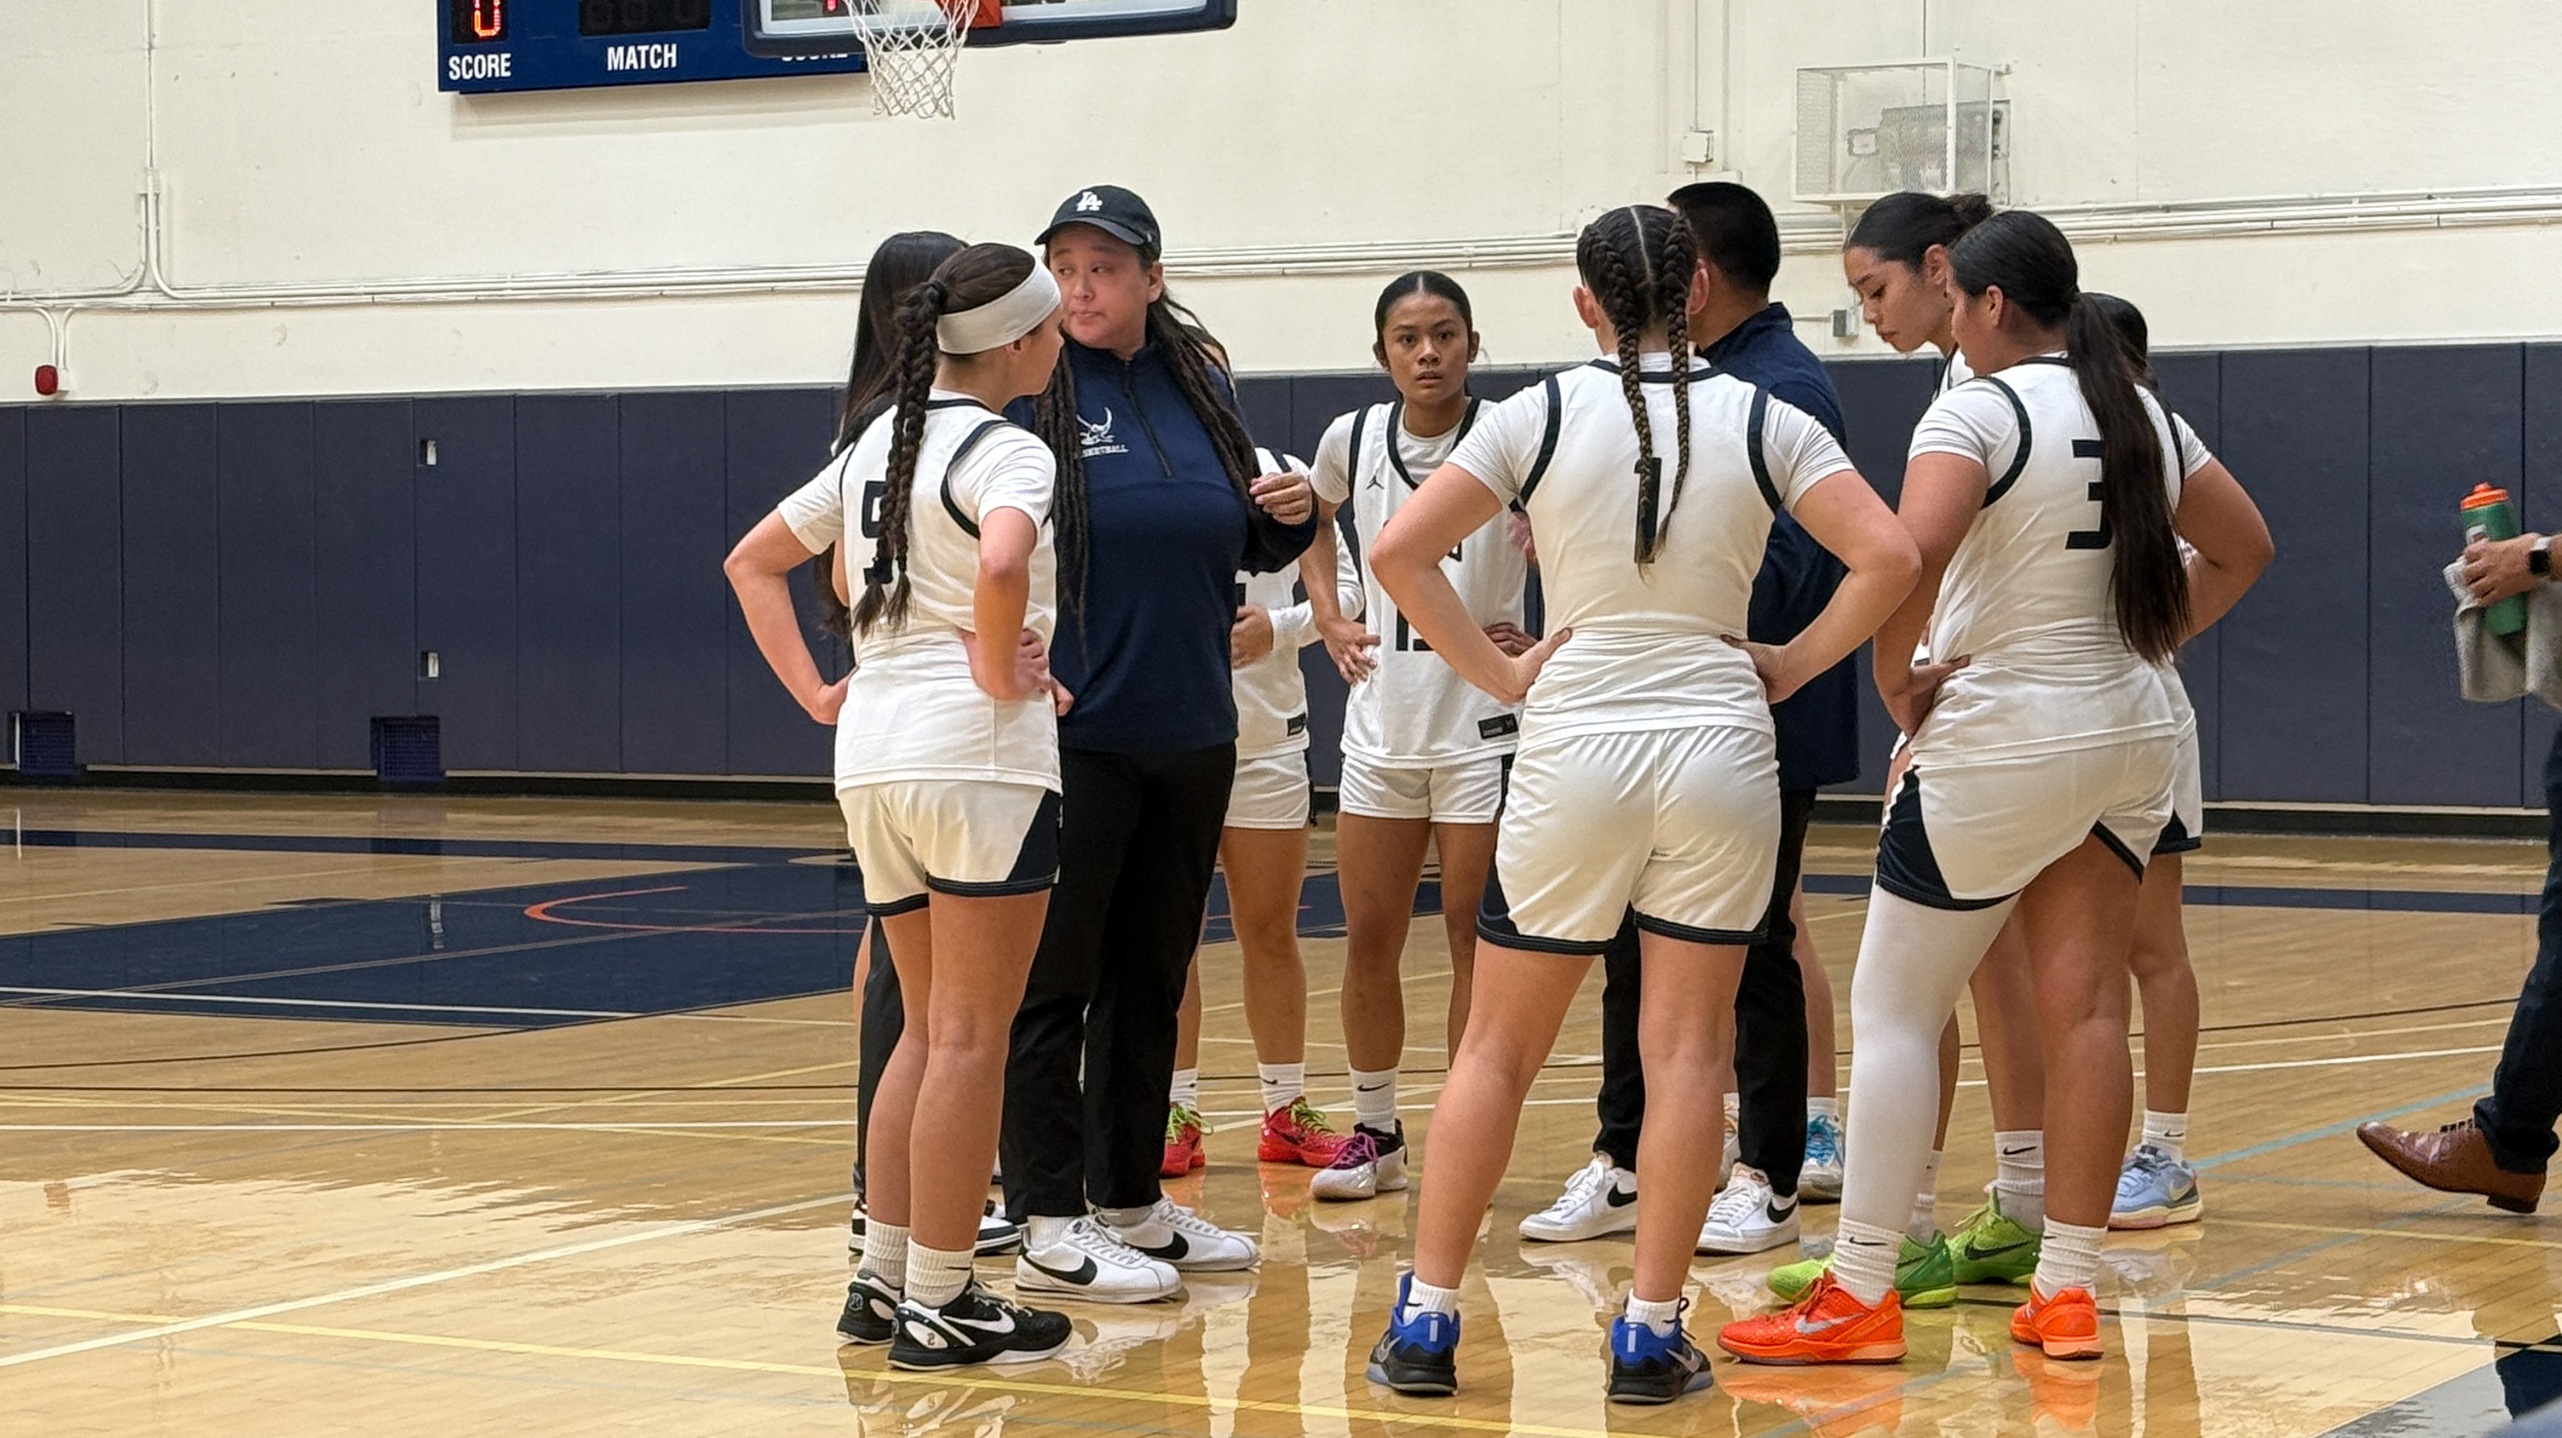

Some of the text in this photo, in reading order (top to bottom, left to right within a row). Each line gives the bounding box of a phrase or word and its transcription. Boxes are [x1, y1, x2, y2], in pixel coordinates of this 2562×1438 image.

[448, 53, 512, 81] SCORE
[606, 43, 678, 72] MATCH
[1076, 191, 1103, 212] LA
[2065, 439, 2114, 550] 3
[1633, 457, 1663, 564] 1
